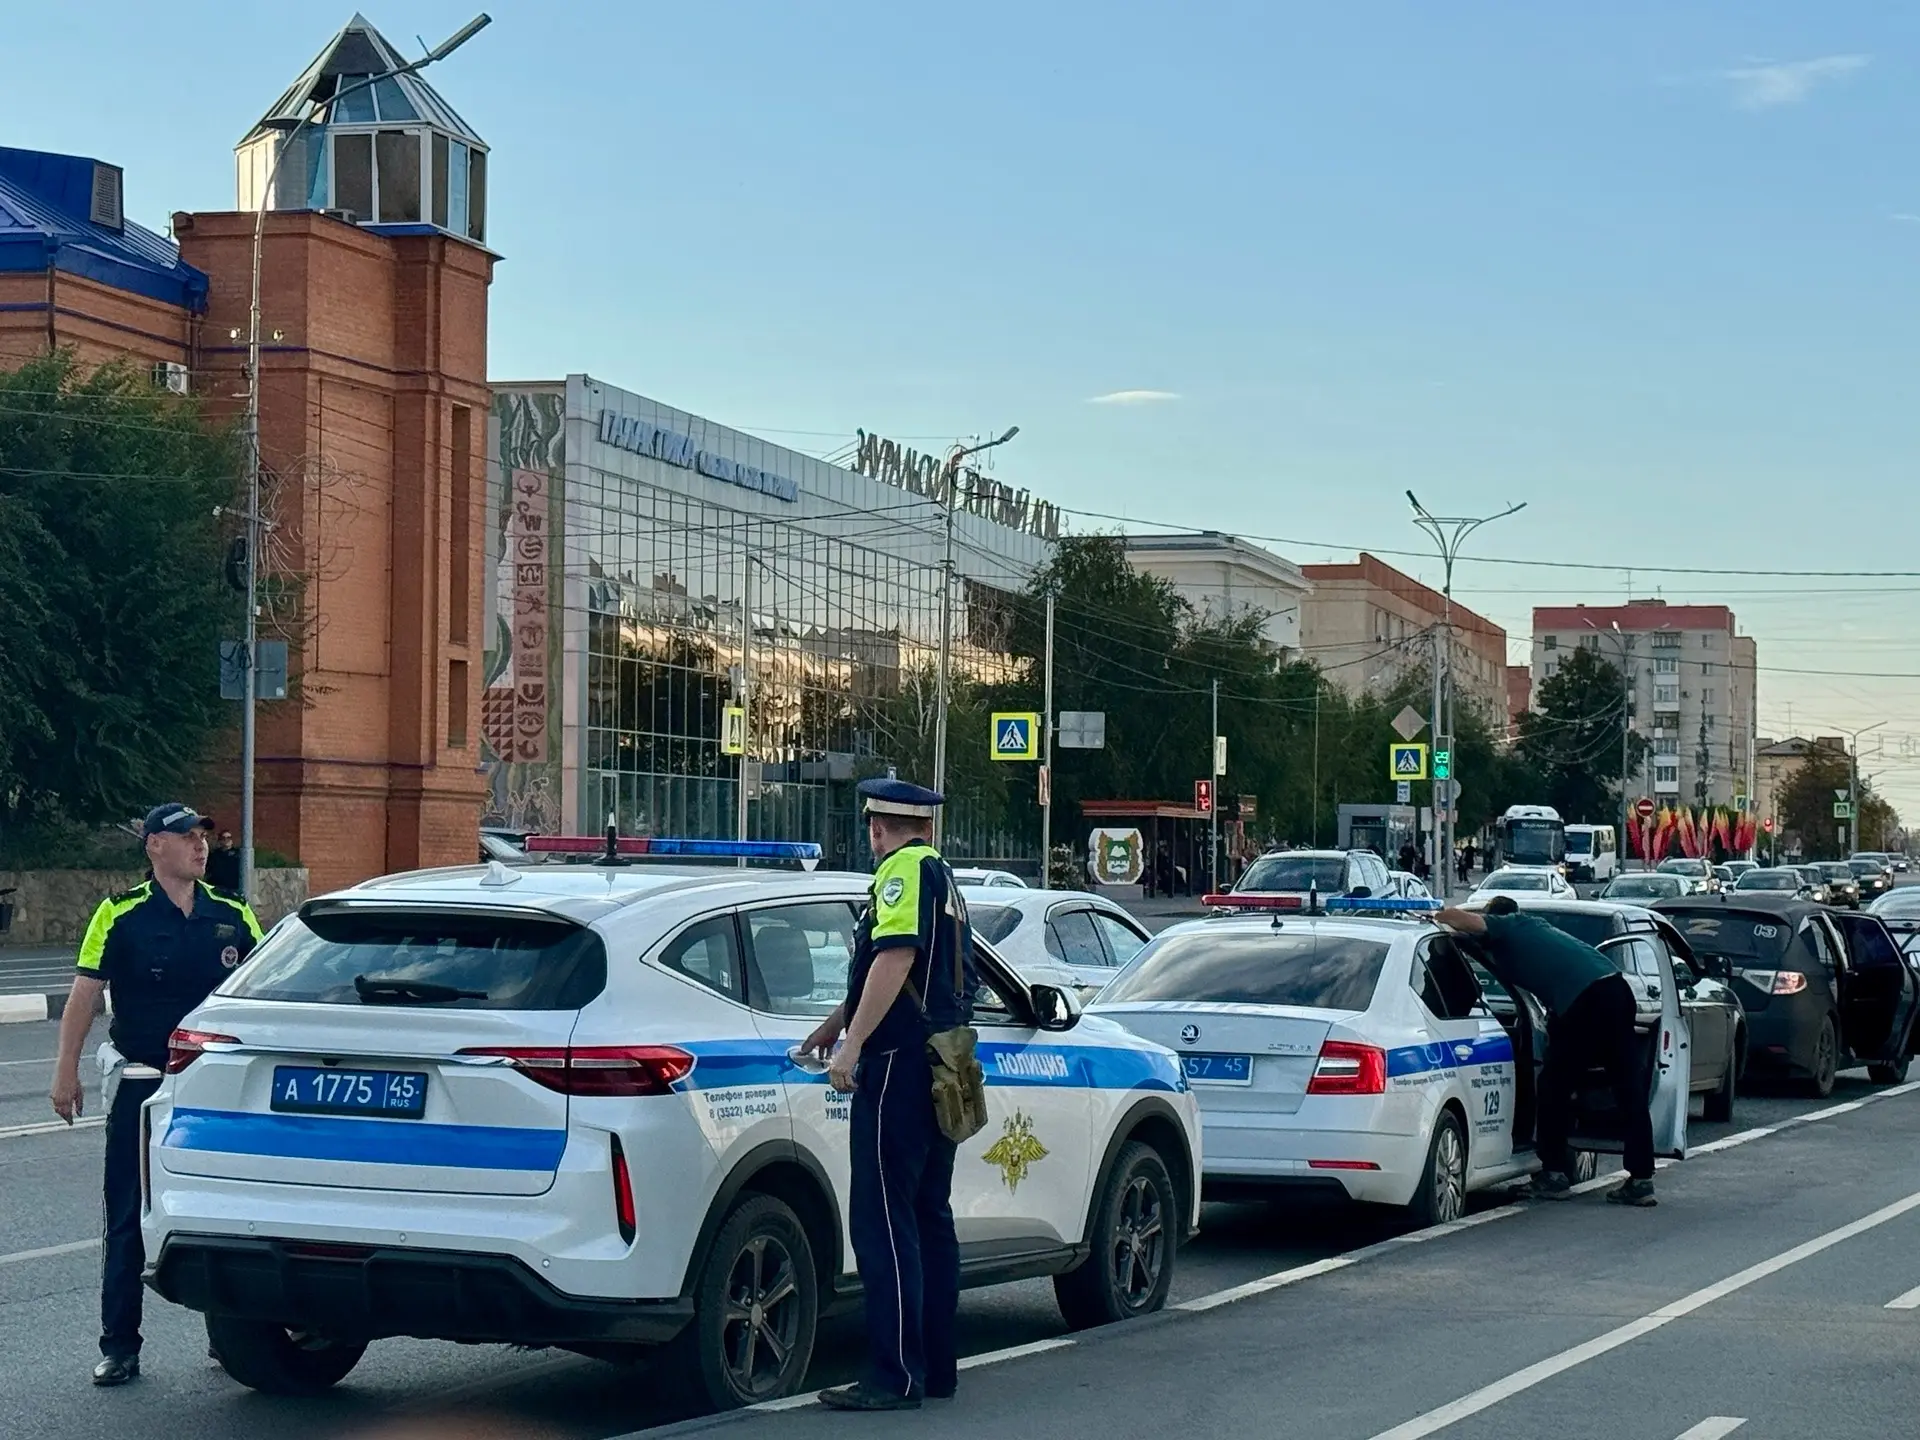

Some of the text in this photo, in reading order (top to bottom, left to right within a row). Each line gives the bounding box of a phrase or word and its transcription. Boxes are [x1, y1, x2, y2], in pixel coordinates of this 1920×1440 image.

[994, 1052, 1069, 1080] ПОЛИЦИЯ
[1224, 1058, 1243, 1072] 45
[285, 1074, 416, 1104] А 1775 45
[703, 1088, 776, 1102] Телефон доверия
[390, 1099, 410, 1107] RUS
[1484, 1090, 1500, 1116] 129
[709, 1108, 715, 1119] 8
[717, 1105, 743, 1120] (3522)
[825, 1107, 849, 1121] УМВД
